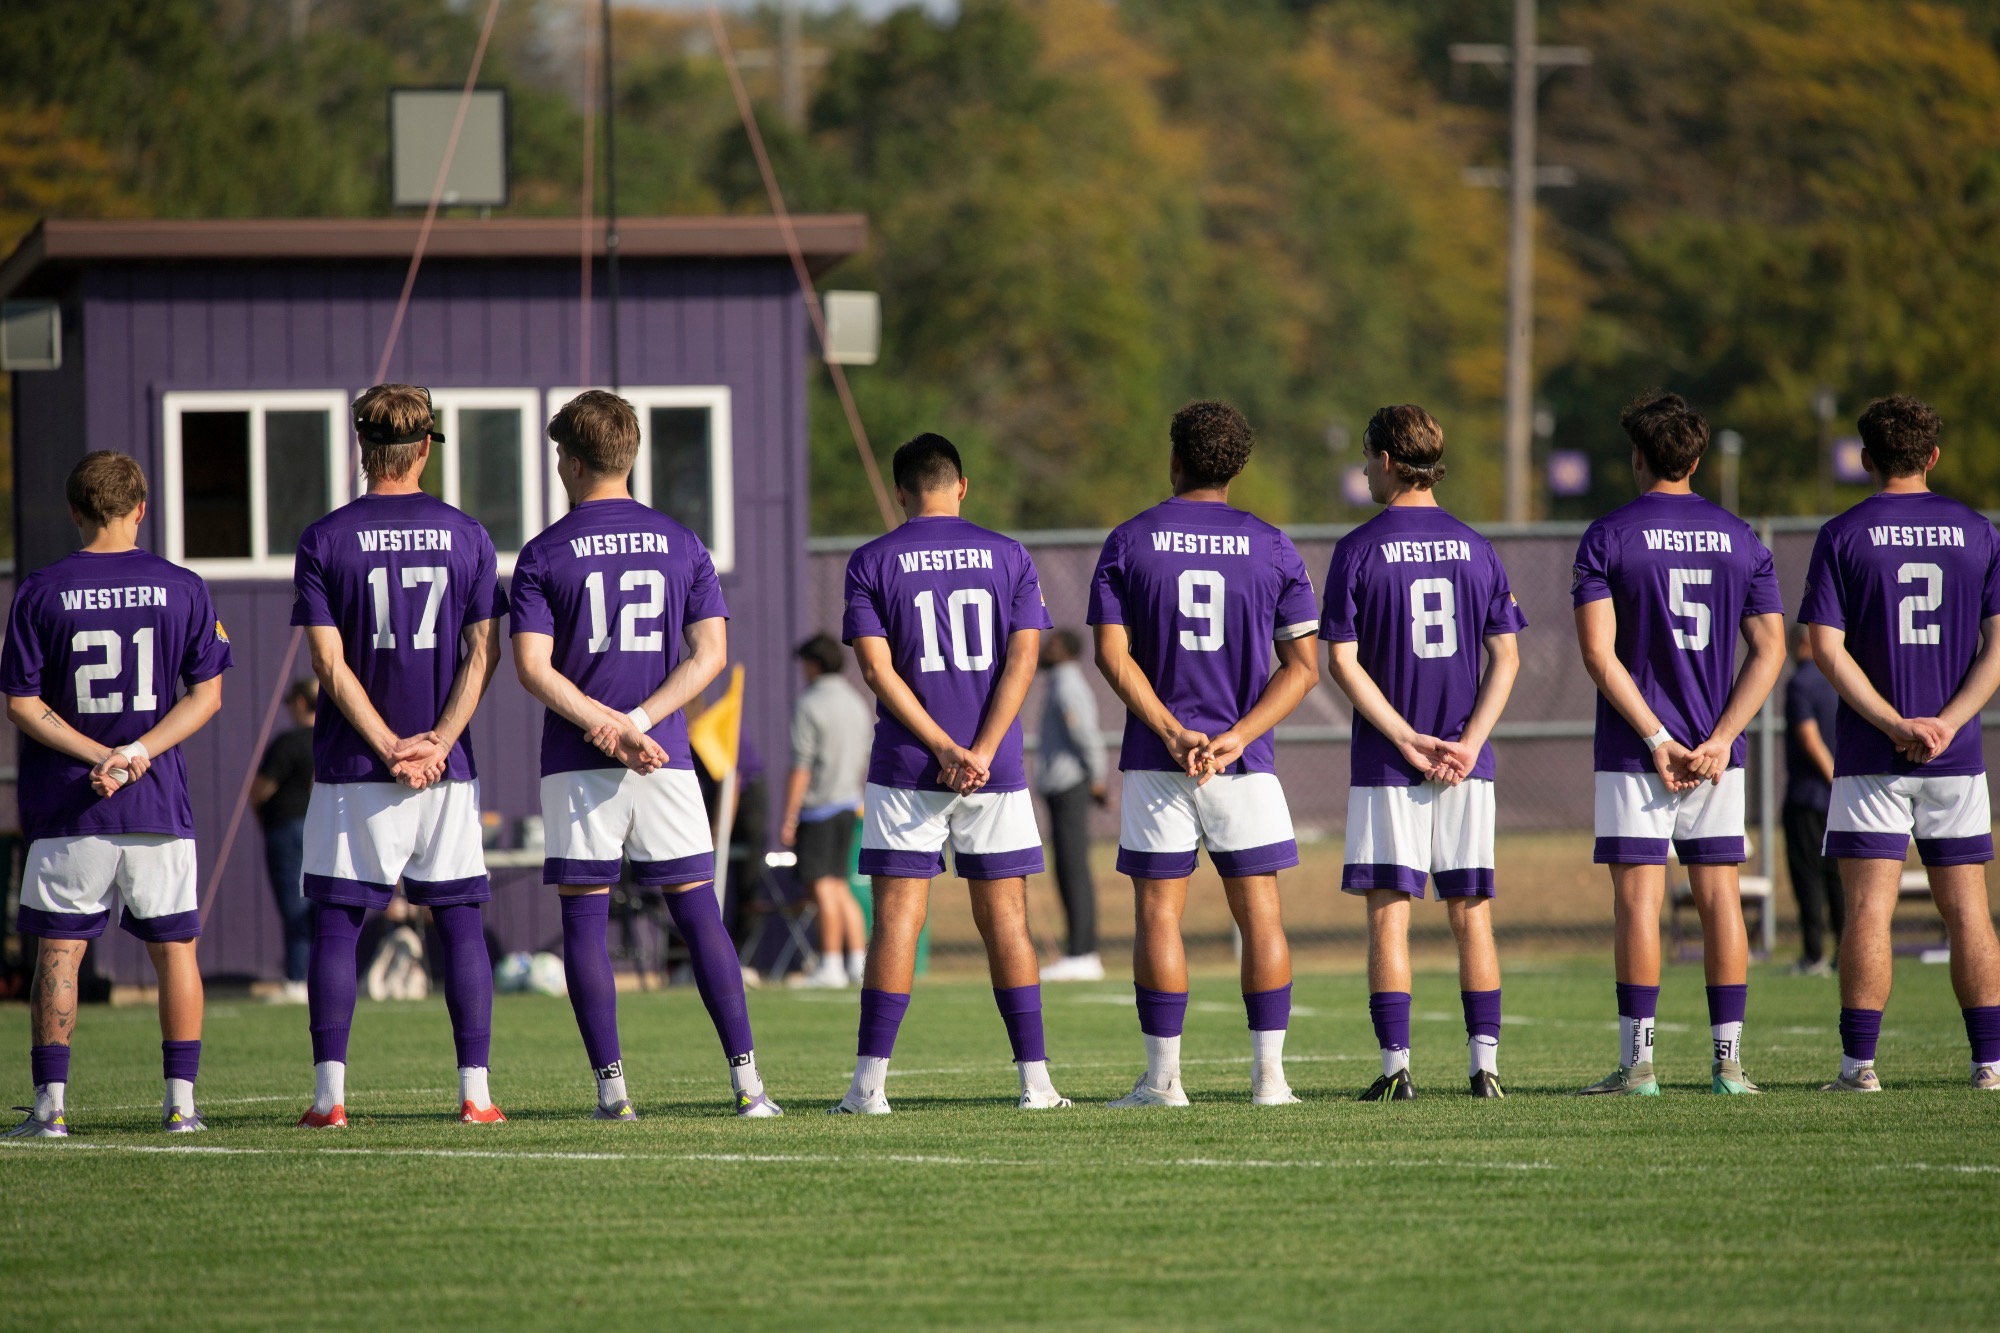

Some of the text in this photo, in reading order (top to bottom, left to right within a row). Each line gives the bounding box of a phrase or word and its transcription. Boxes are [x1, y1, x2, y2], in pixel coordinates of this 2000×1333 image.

[356, 529, 452, 552] WESTERN
[569, 532, 669, 559] WESTERN
[897, 548, 993, 574] WESTERN
[1150, 531, 1250, 556] WESTERN
[1380, 539, 1471, 564] WESTERN
[1642, 528, 1732, 554] WESTERN
[1867, 525, 1965, 548] WESTERN
[59, 585, 167, 611] WESTERN
[366, 566, 449, 650] 17
[584, 569, 666, 654] 12
[1177, 569, 1226, 652] 9
[1409, 577, 1458, 659] 8
[1668, 568, 1713, 651] 5
[1896, 562, 1943, 645] 2
[913, 588, 993, 673] 10
[71, 627, 158, 714] 21
